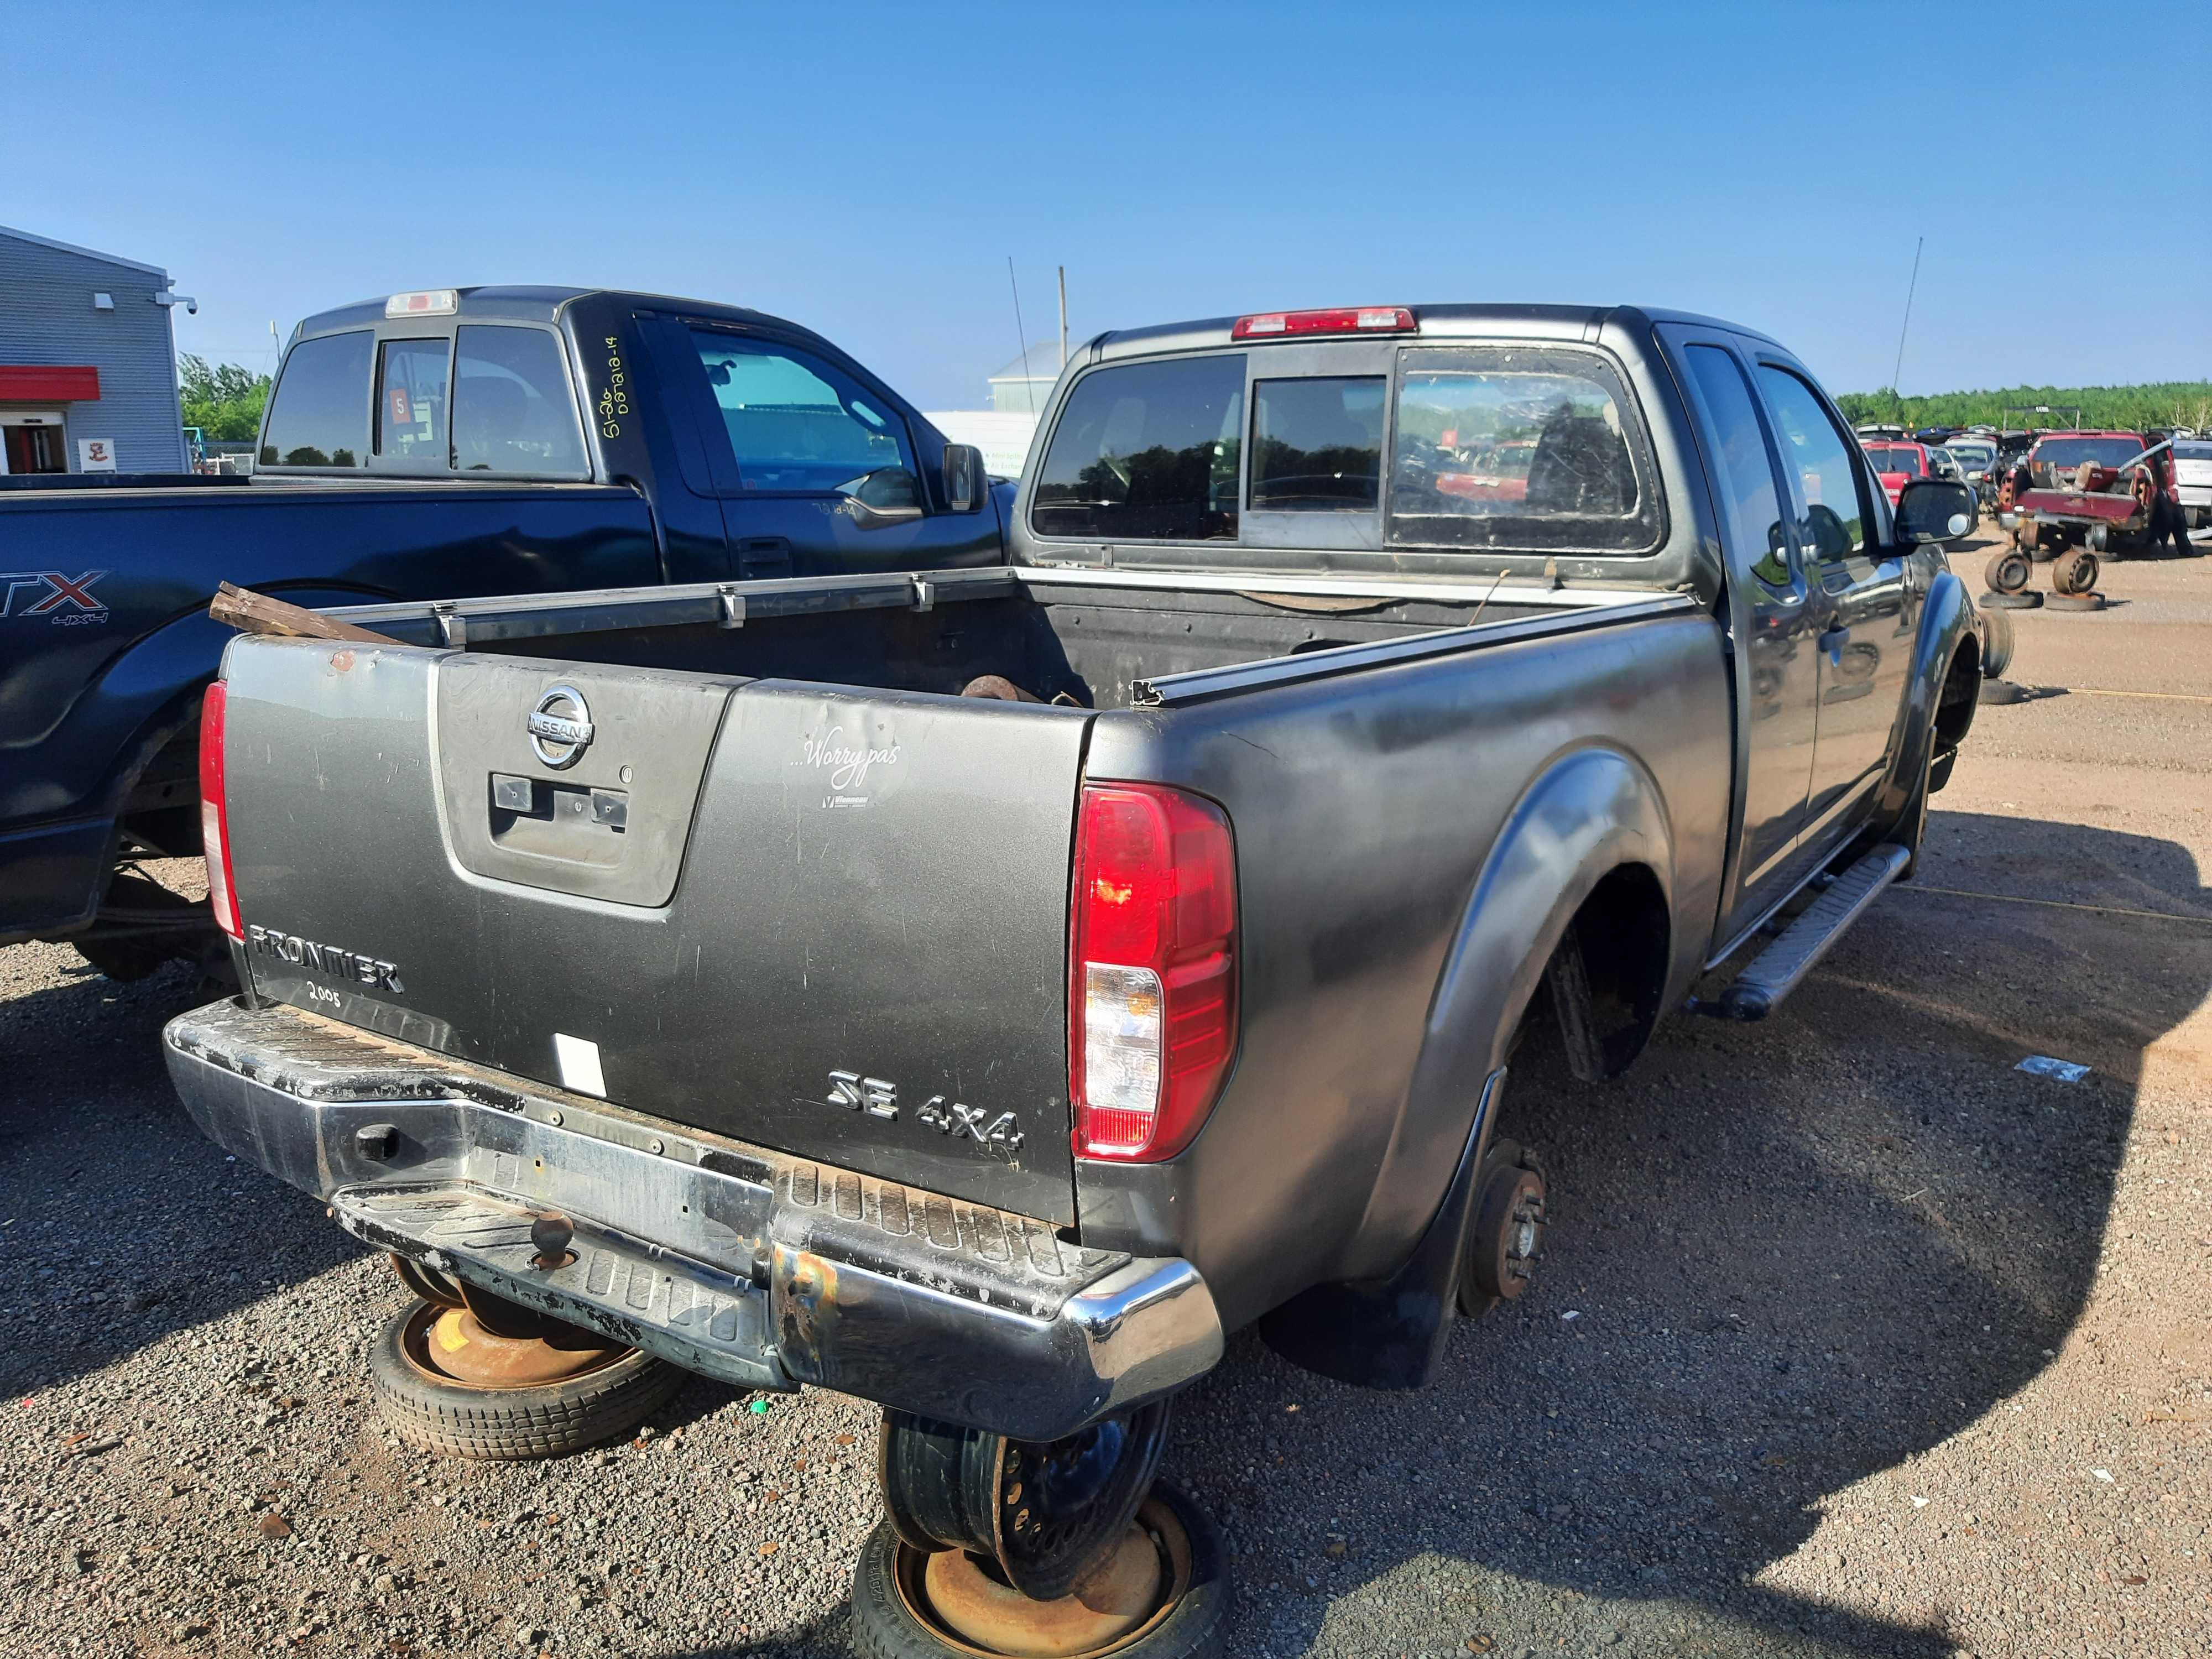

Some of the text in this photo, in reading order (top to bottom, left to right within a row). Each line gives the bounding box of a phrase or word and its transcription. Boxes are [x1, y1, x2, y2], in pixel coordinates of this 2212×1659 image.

[530, 717, 581, 738] NISSAN
[855, 745, 901, 788] pas
[249, 924, 405, 995] FRONTIER
[306, 980, 341, 1009] 2005
[827, 1068, 899, 1121] SE
